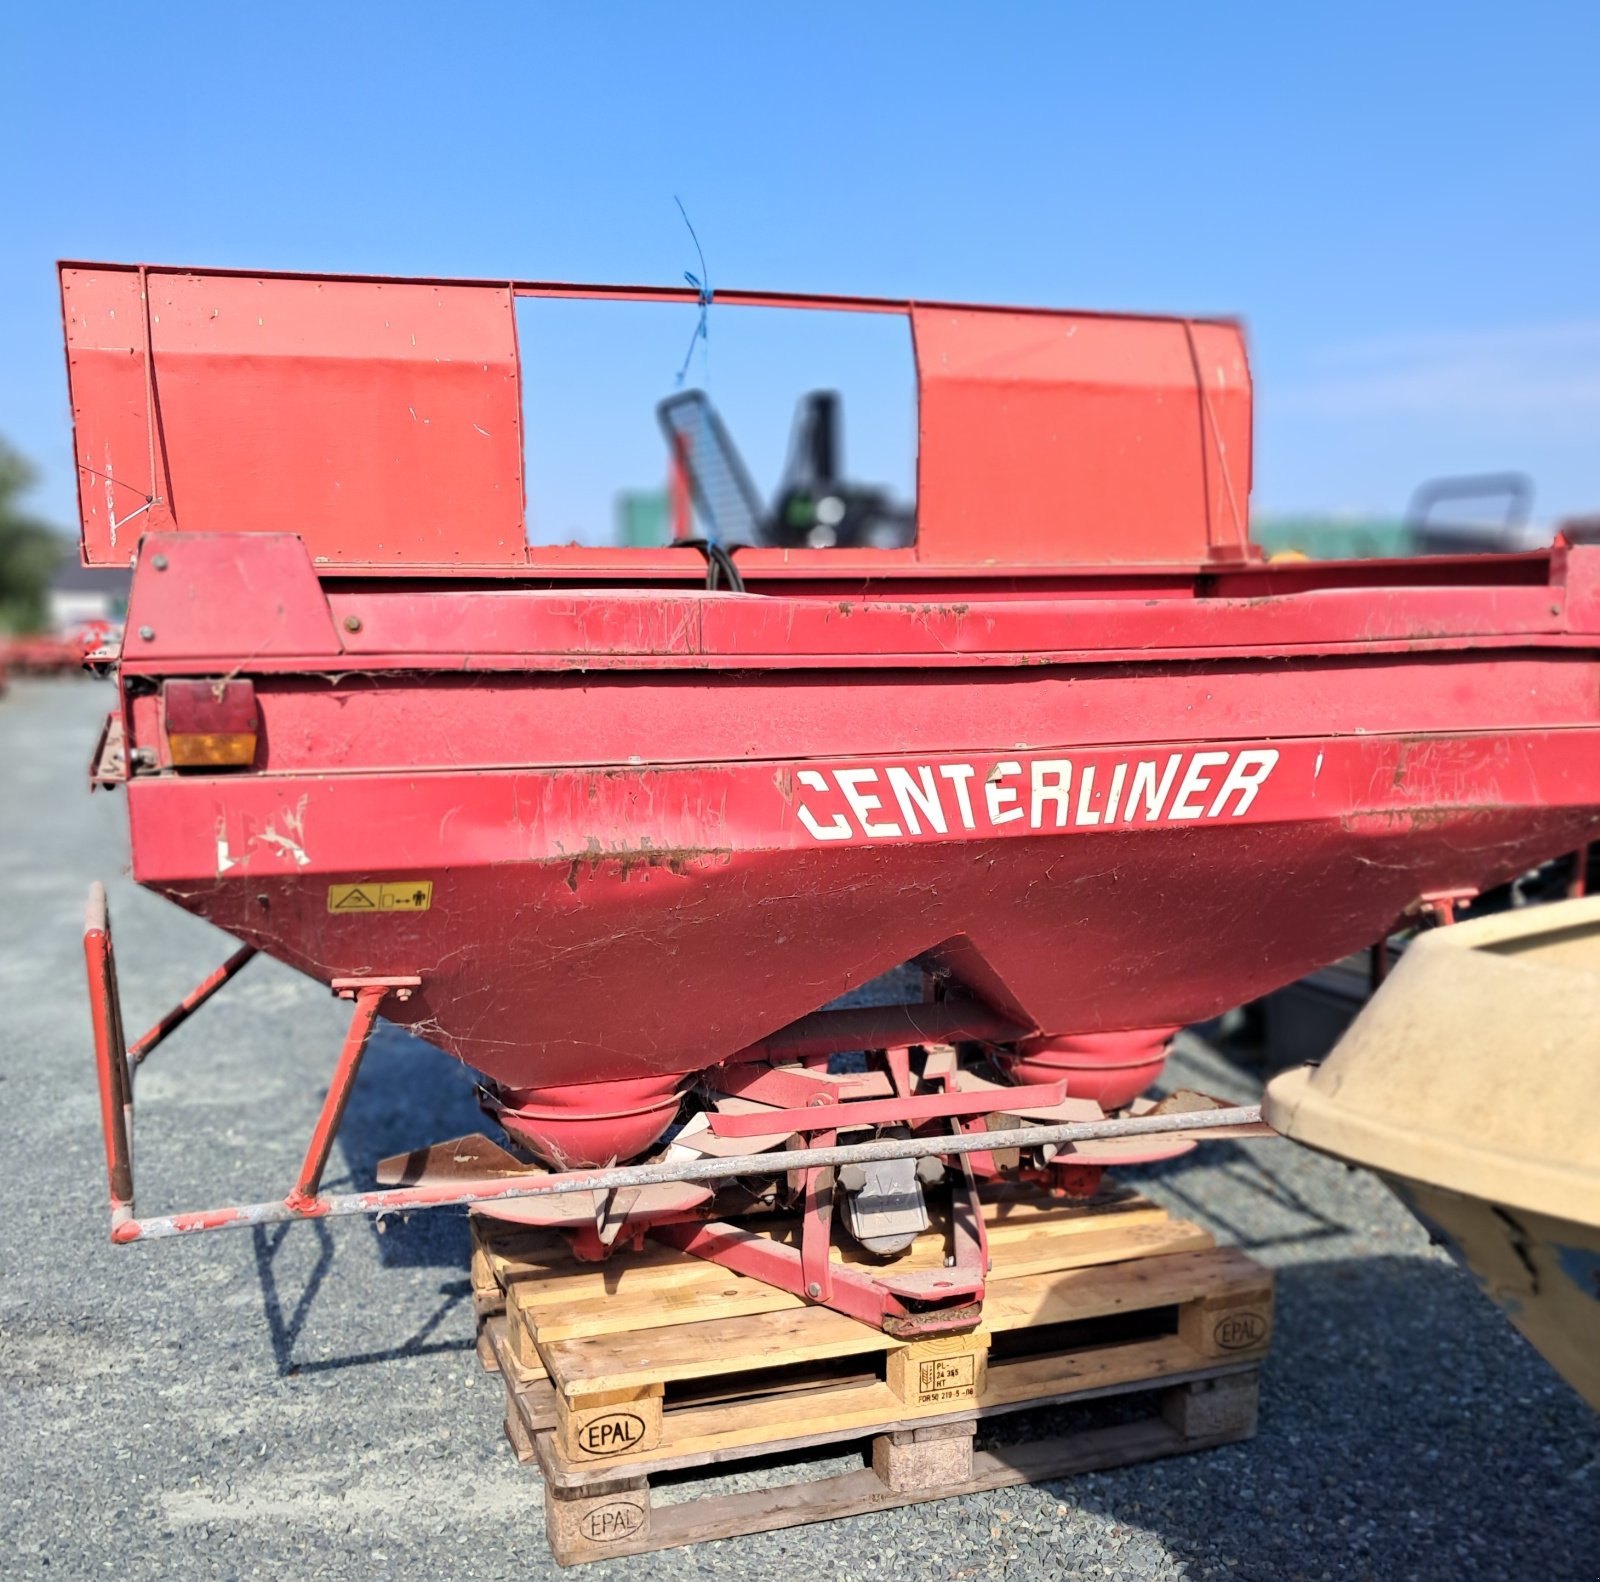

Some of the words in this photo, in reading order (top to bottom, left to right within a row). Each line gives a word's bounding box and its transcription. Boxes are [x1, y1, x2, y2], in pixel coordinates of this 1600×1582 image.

[796, 748, 1280, 842] CENTERLINER
[1222, 1319, 1261, 1343] EPAL
[936, 1379, 946, 1388] HT
[588, 1420, 636, 1448] EPAL
[591, 1508, 637, 1537] EPAL
